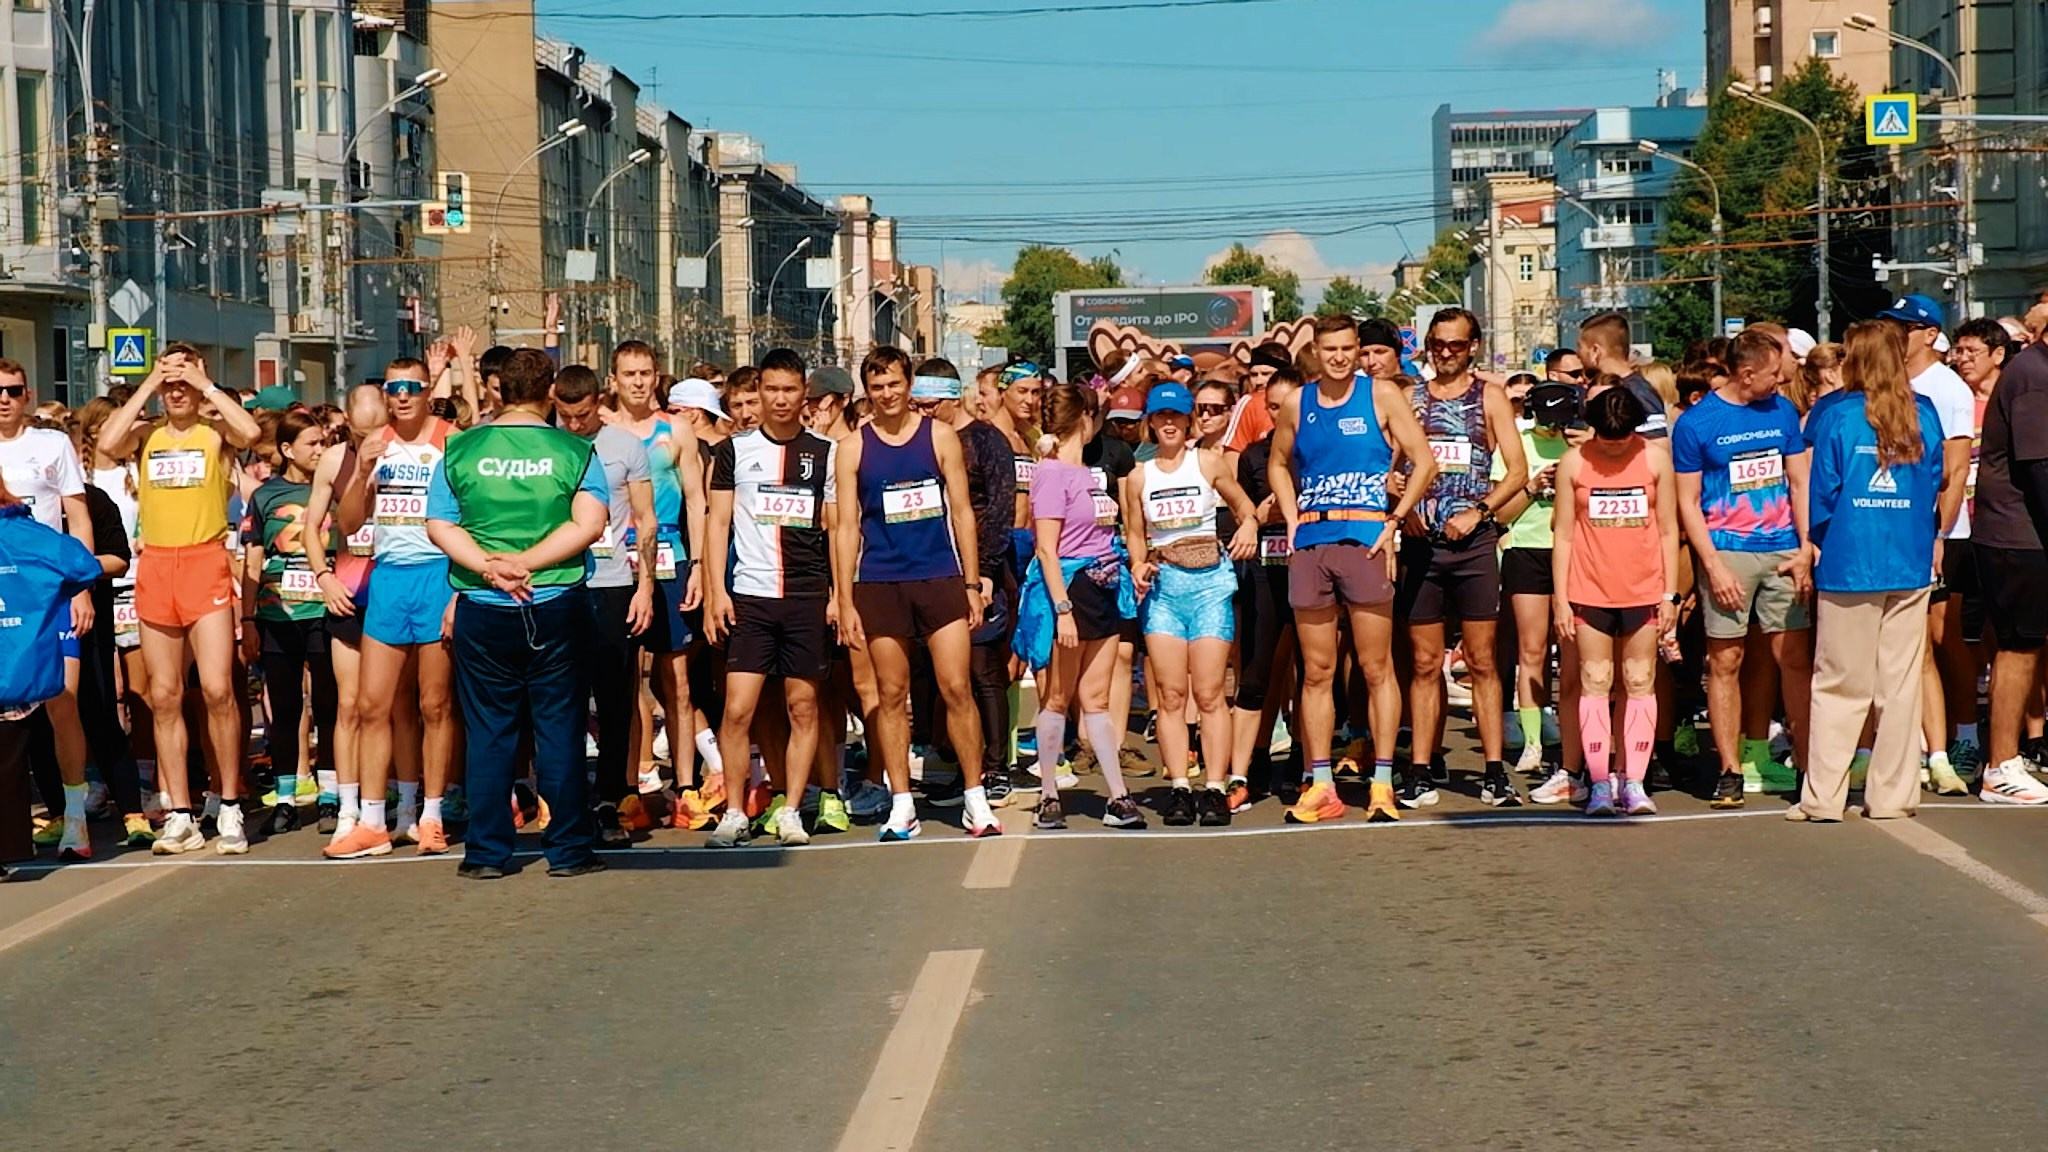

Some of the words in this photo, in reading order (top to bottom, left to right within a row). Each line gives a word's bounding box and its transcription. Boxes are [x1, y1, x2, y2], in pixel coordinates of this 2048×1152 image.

[1074, 314, 1092, 326] От
[1153, 314, 1170, 326] до
[1174, 312, 1199, 324] IPO
[1716, 429, 1782, 446] СОВКОМБАНК
[378, 463, 431, 482] RUSSIA
[477, 457, 553, 480] СУДЬЯ
[1737, 459, 1777, 479] 1657
[380, 498, 421, 513] 2320
[763, 496, 806, 514] 1673
[902, 491, 924, 509] 23
[1156, 499, 1196, 517] 2132
[1598, 499, 1640, 515] 2231
[1852, 498, 1911, 509] VOLUNTEER
